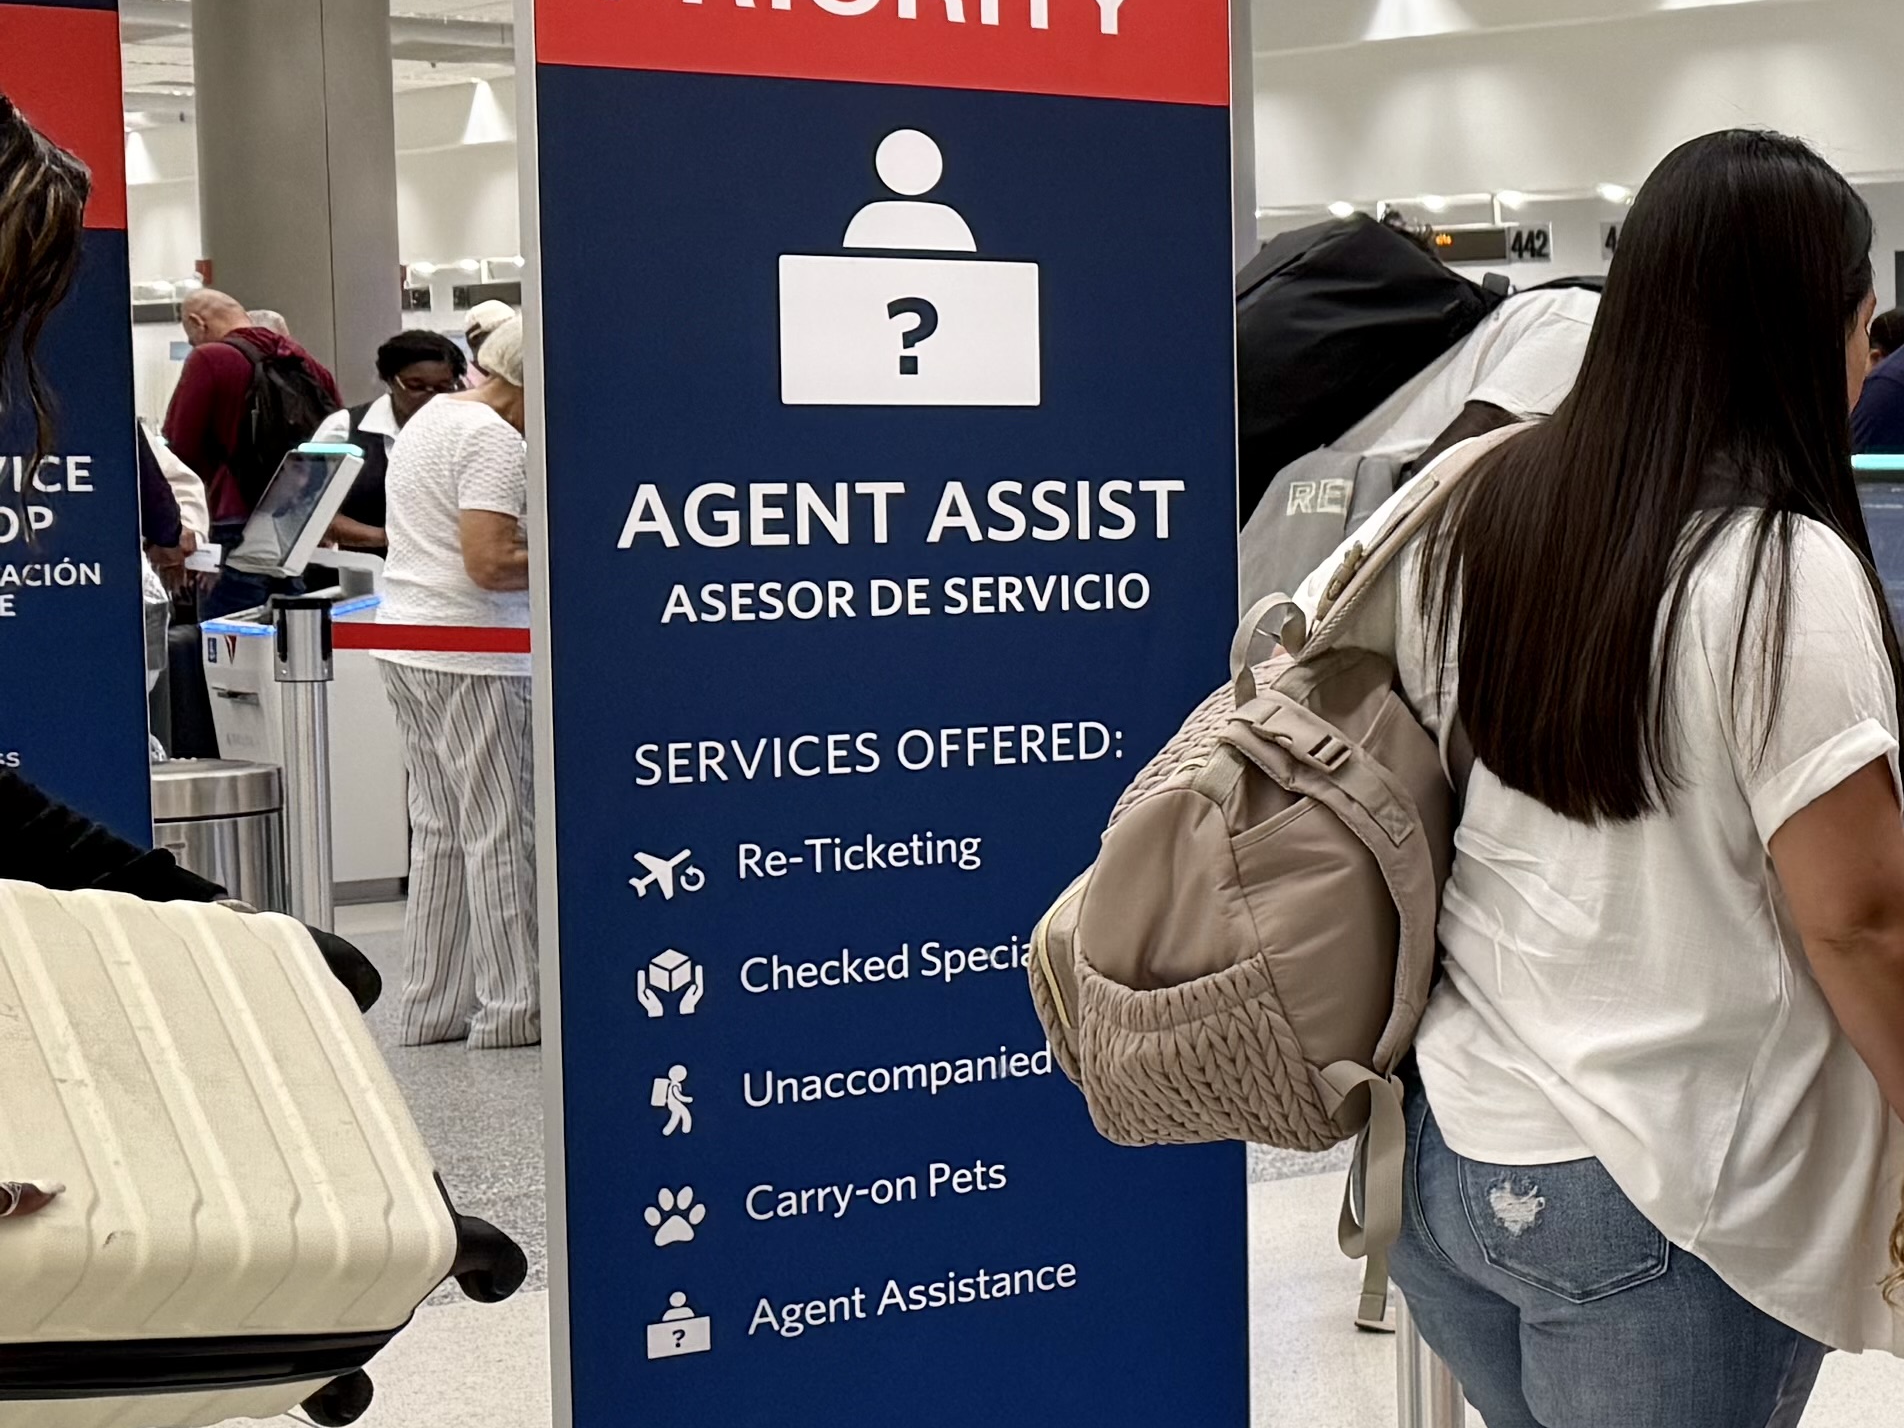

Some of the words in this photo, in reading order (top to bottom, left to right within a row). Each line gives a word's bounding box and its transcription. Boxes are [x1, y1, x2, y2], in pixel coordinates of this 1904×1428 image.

[1511, 228, 1549, 259] 442
[618, 482, 905, 548] AGENT
[927, 480, 1185, 542] ASSIST
[0, 557, 101, 586] ACIÓN
[661, 581, 856, 623] ASESOR
[871, 579, 930, 616] DE
[945, 573, 1149, 614] SERVICIO
[636, 733, 879, 785] SERVICES
[898, 722, 1122, 770] OFFERED:
[740, 832, 981, 878] Re-Ticketing
[741, 944, 908, 992] Checked
[921, 936, 1031, 982] Specia
[744, 1040, 1052, 1106] Unaccompanied
[746, 1176, 916, 1220] Carry-on
[930, 1160, 1006, 1197] Pets
[749, 1287, 866, 1337] Agent
[877, 1264, 1076, 1315] Assistance
